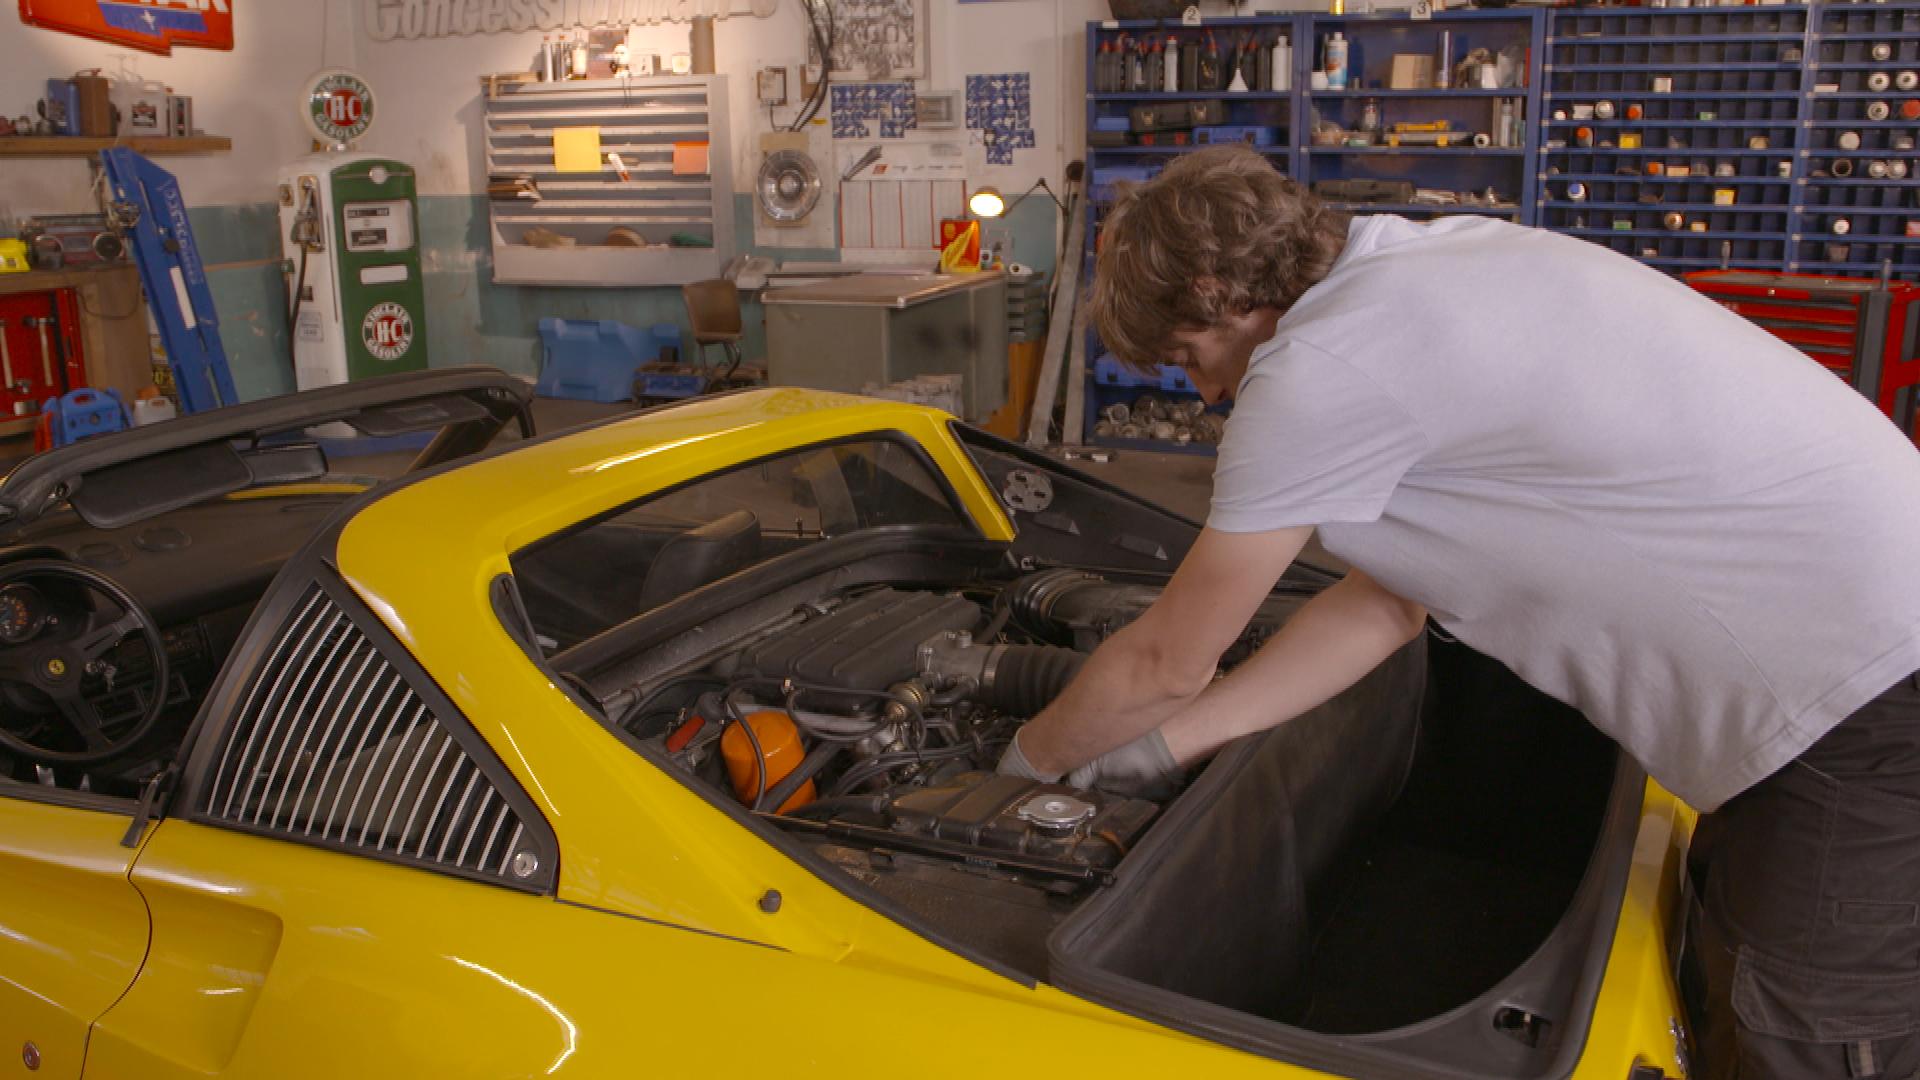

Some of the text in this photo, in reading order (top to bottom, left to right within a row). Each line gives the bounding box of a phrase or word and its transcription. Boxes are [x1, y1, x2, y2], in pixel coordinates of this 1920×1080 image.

[1187, 9, 1198, 21] 2
[1416, 1, 1427, 15] 3
[314, 112, 370, 138] GASOLINE
